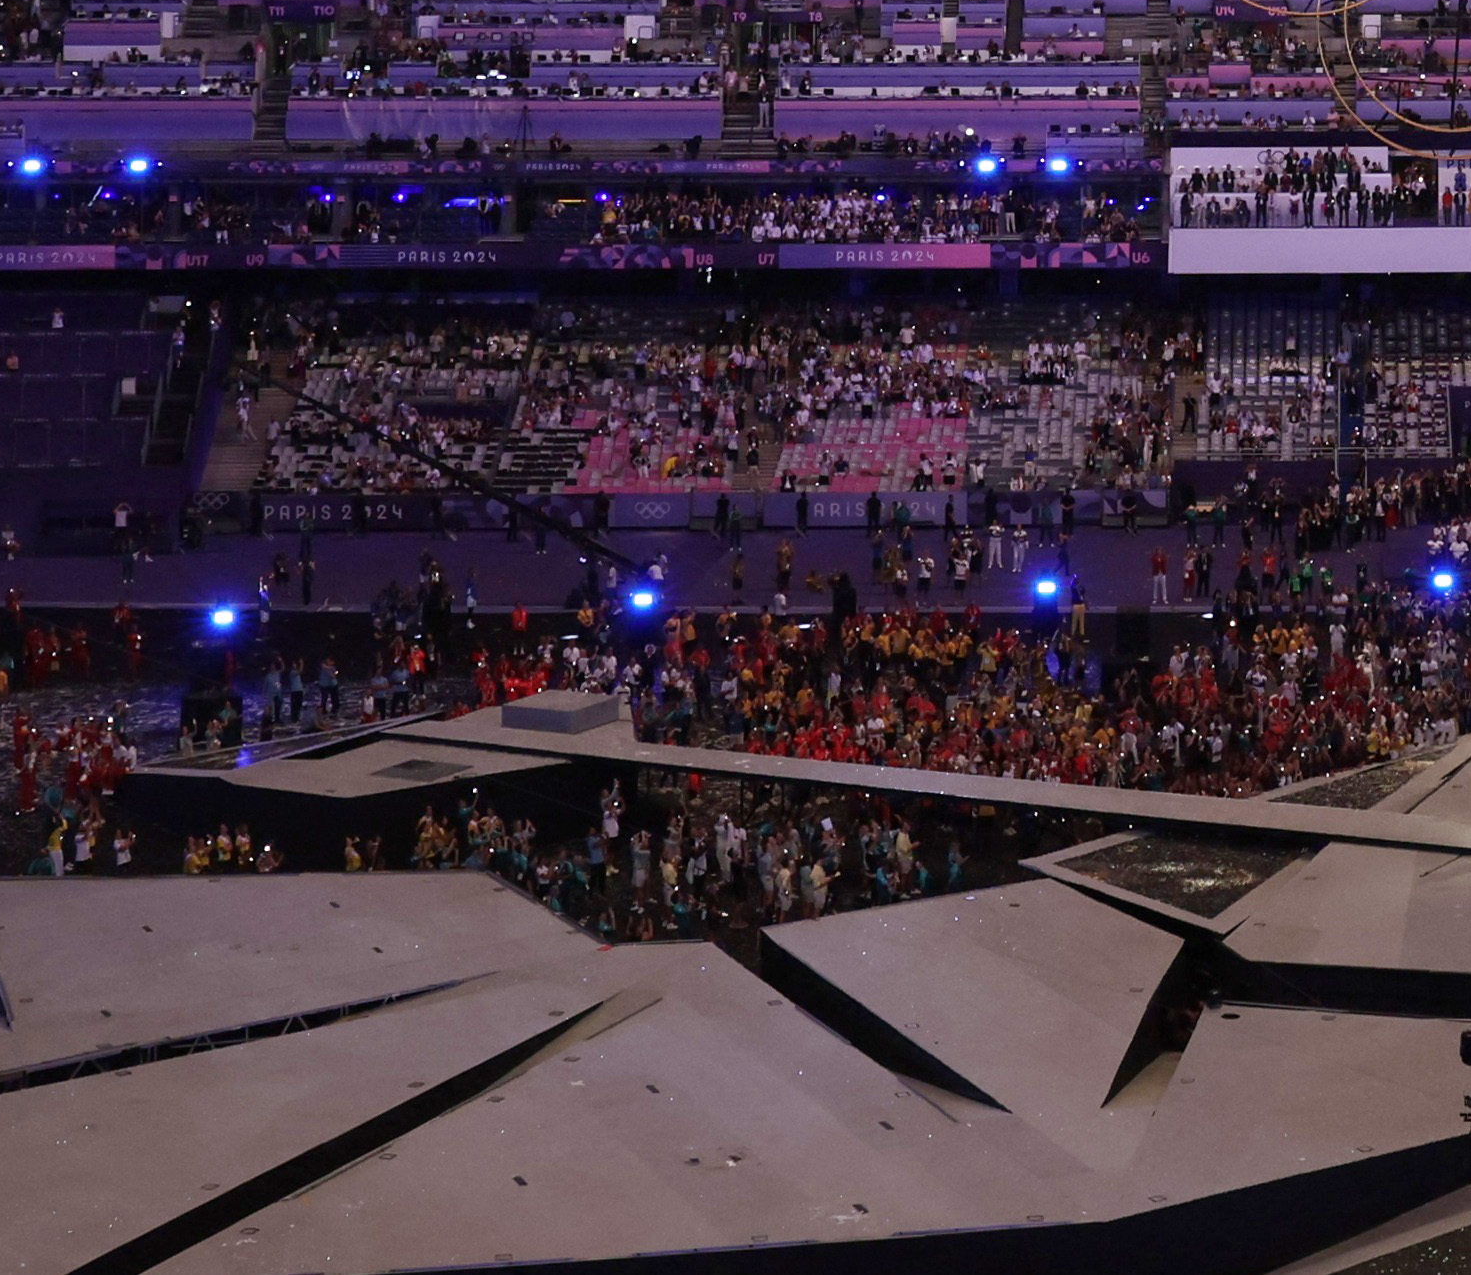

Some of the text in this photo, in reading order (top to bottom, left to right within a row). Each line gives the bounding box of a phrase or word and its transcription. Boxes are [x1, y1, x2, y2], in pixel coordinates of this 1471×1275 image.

[268, 6, 284, 16] T11
[313, 5, 335, 16] T10
[808, 11, 823, 21] T8
[1215, 6, 1235, 16] U14
[732, 12, 747, 22] T9
[526, 163, 553, 171] PARIS
[51, 251, 96, 264] 2024
[187, 254, 209, 267] U17
[246, 254, 265, 266] U9
[398, 251, 497, 263] PARIS 2024
[696, 253, 714, 266] U8
[757, 253, 775, 266] U7
[836, 250, 935, 262] PARIS 2024
[1132, 251, 1150, 264] U6
